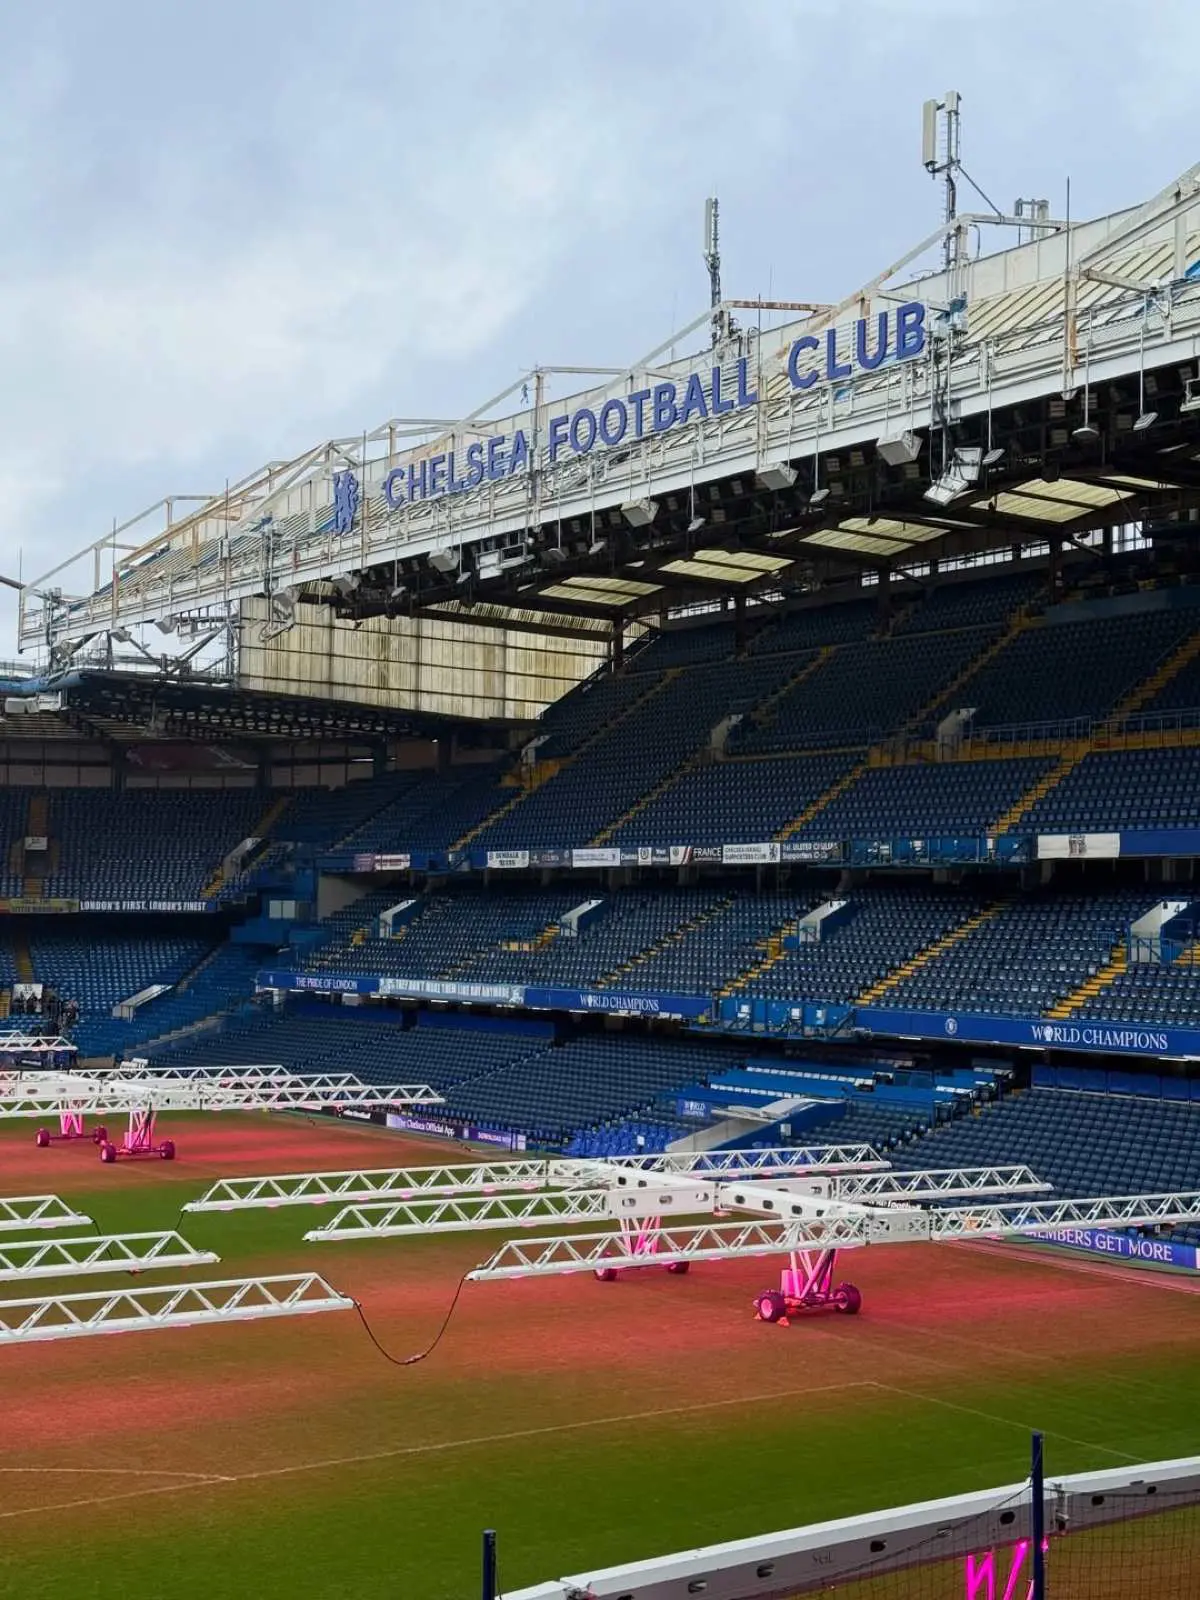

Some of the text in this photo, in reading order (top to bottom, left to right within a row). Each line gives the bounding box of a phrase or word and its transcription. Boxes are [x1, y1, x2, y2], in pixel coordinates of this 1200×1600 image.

[384, 301, 926, 509] CHELSEA FOOTBALL CLUB
[693, 847, 721, 857] FRANCE
[80, 901, 120, 911] LONDON'S
[295, 976, 306, 987] THE
[307, 978, 323, 988] PRIDE
[332, 979, 358, 991] LONDON
[610, 996, 659, 1012] CHAMPIONS
[1031, 1025, 1168, 1050] WORLD CHAMPIONS
[425, 1121, 443, 1133] Official
[444, 1126, 455, 1138] App
[1094, 1233, 1124, 1253] GET
[1128, 1239, 1173, 1262] MORE
